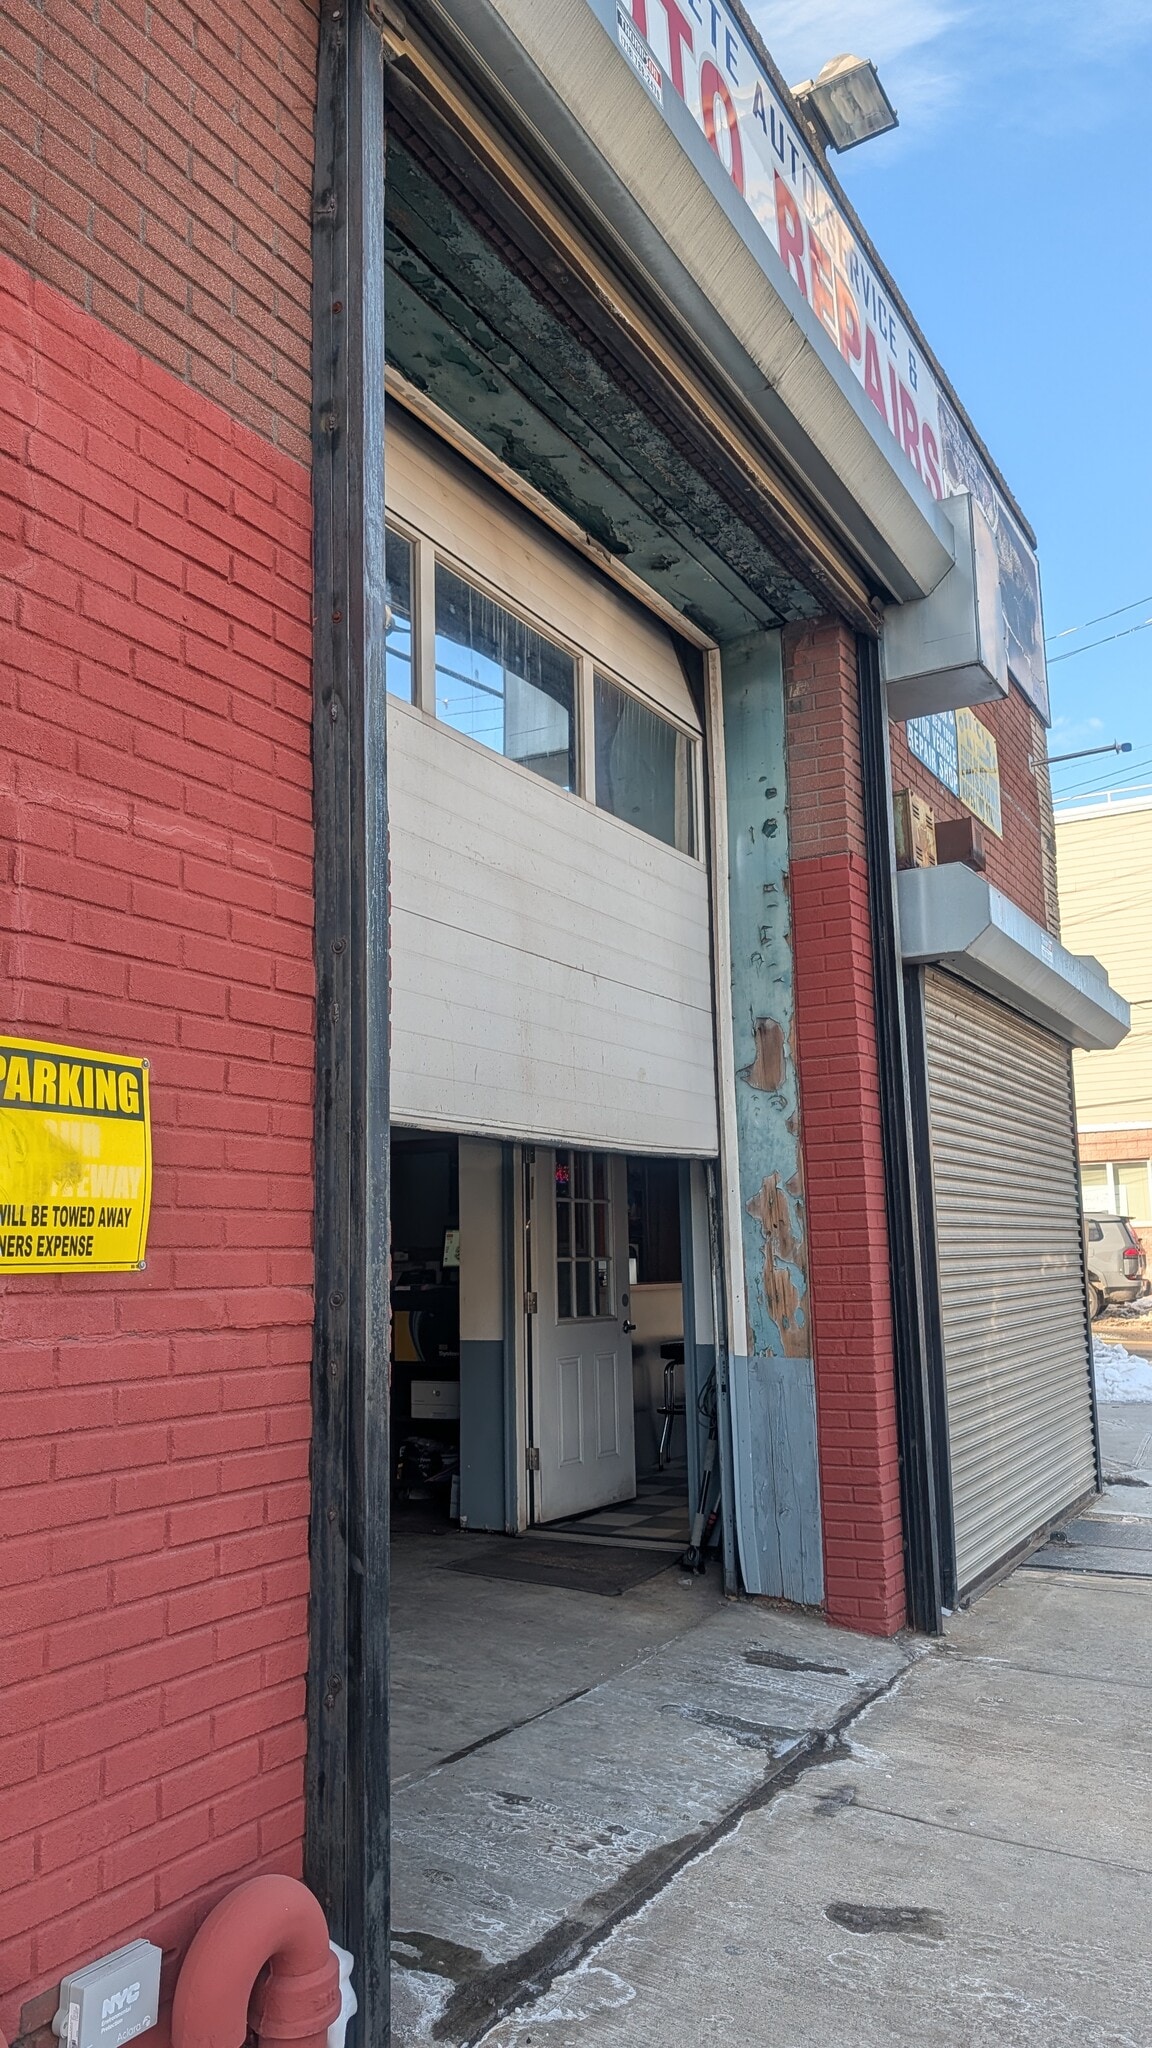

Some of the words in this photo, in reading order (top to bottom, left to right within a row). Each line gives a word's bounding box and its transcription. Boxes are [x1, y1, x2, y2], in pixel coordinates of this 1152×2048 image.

[753, 81, 816, 218] AUTO
[825, 213, 897, 358] SERVICE
[908, 348, 918, 393] &
[774, 168, 943, 500] REPAIRS
[907, 723, 937, 772] REPAIR
[940, 757, 958, 789] SHOP
[932, 726, 957, 770] VEHICLE
[31, 1205, 48, 1227] BE
[52, 1206, 95, 1227] TOWED
[98, 1207, 132, 1228] AWAY
[36, 1235, 94, 1257] EXPENSE
[102, 1982, 140, 2019] NYC
[117, 2023, 142, 2043] Aclara
